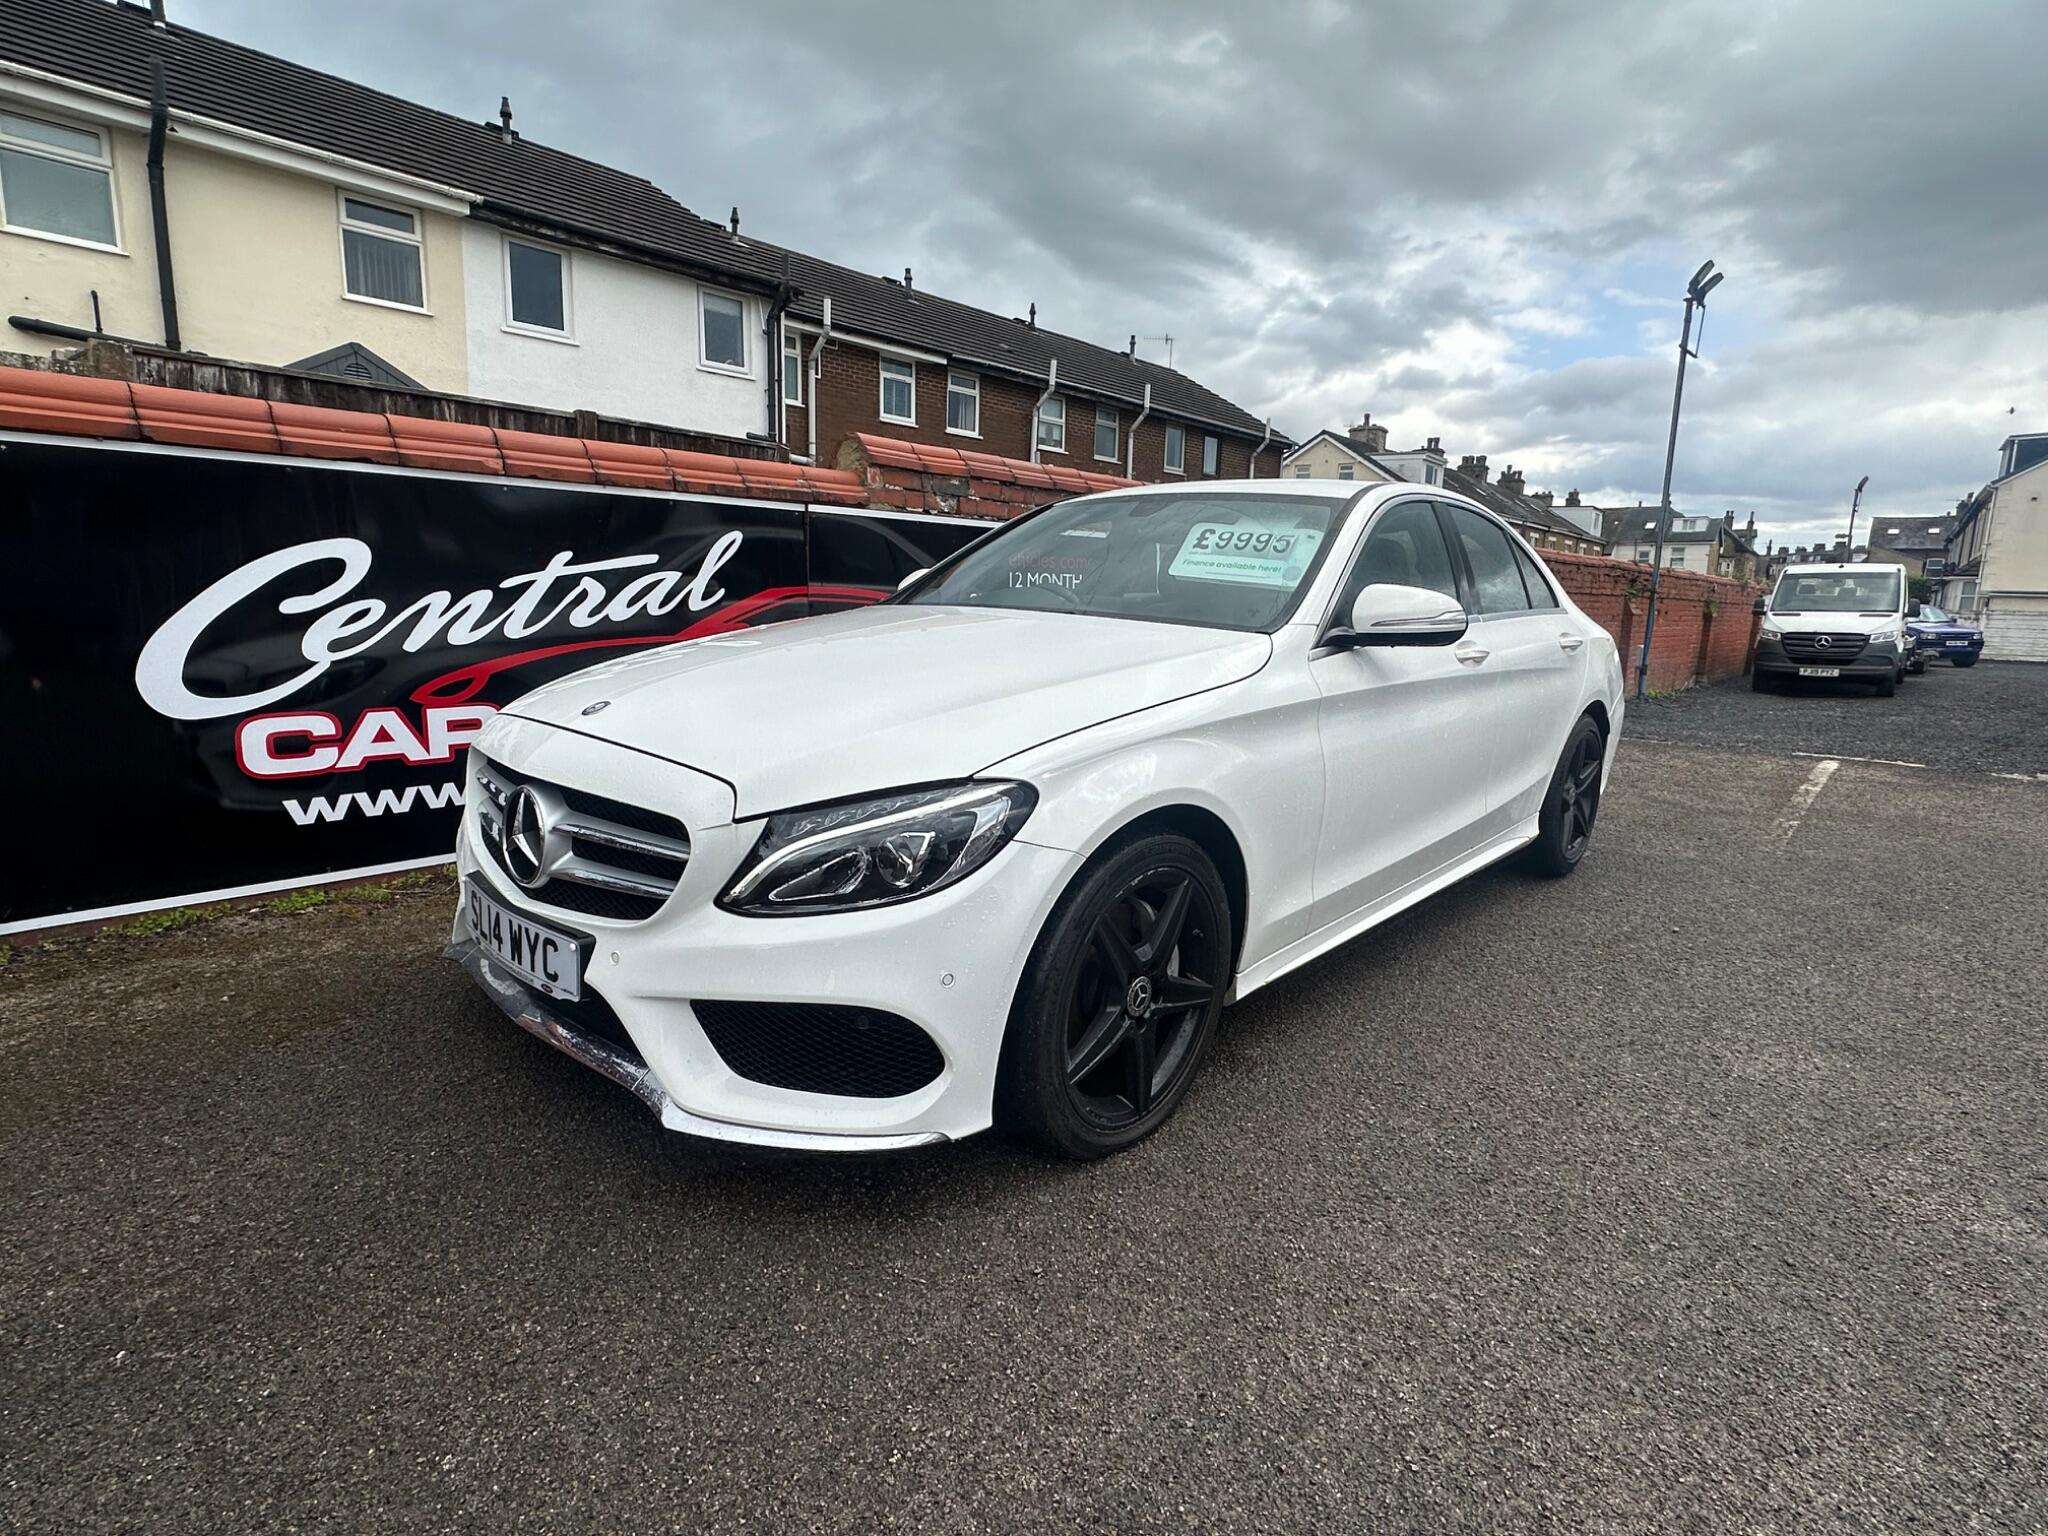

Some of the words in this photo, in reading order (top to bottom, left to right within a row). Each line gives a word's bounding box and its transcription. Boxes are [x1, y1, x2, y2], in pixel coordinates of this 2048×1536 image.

[1193, 528, 1294, 553] £9995
[1216, 560, 1257, 571] available
[1009, 571, 1023, 588] 12
[135, 530, 743, 720] Central
[471, 889, 503, 953] SL14
[508, 918, 560, 983] WYC
